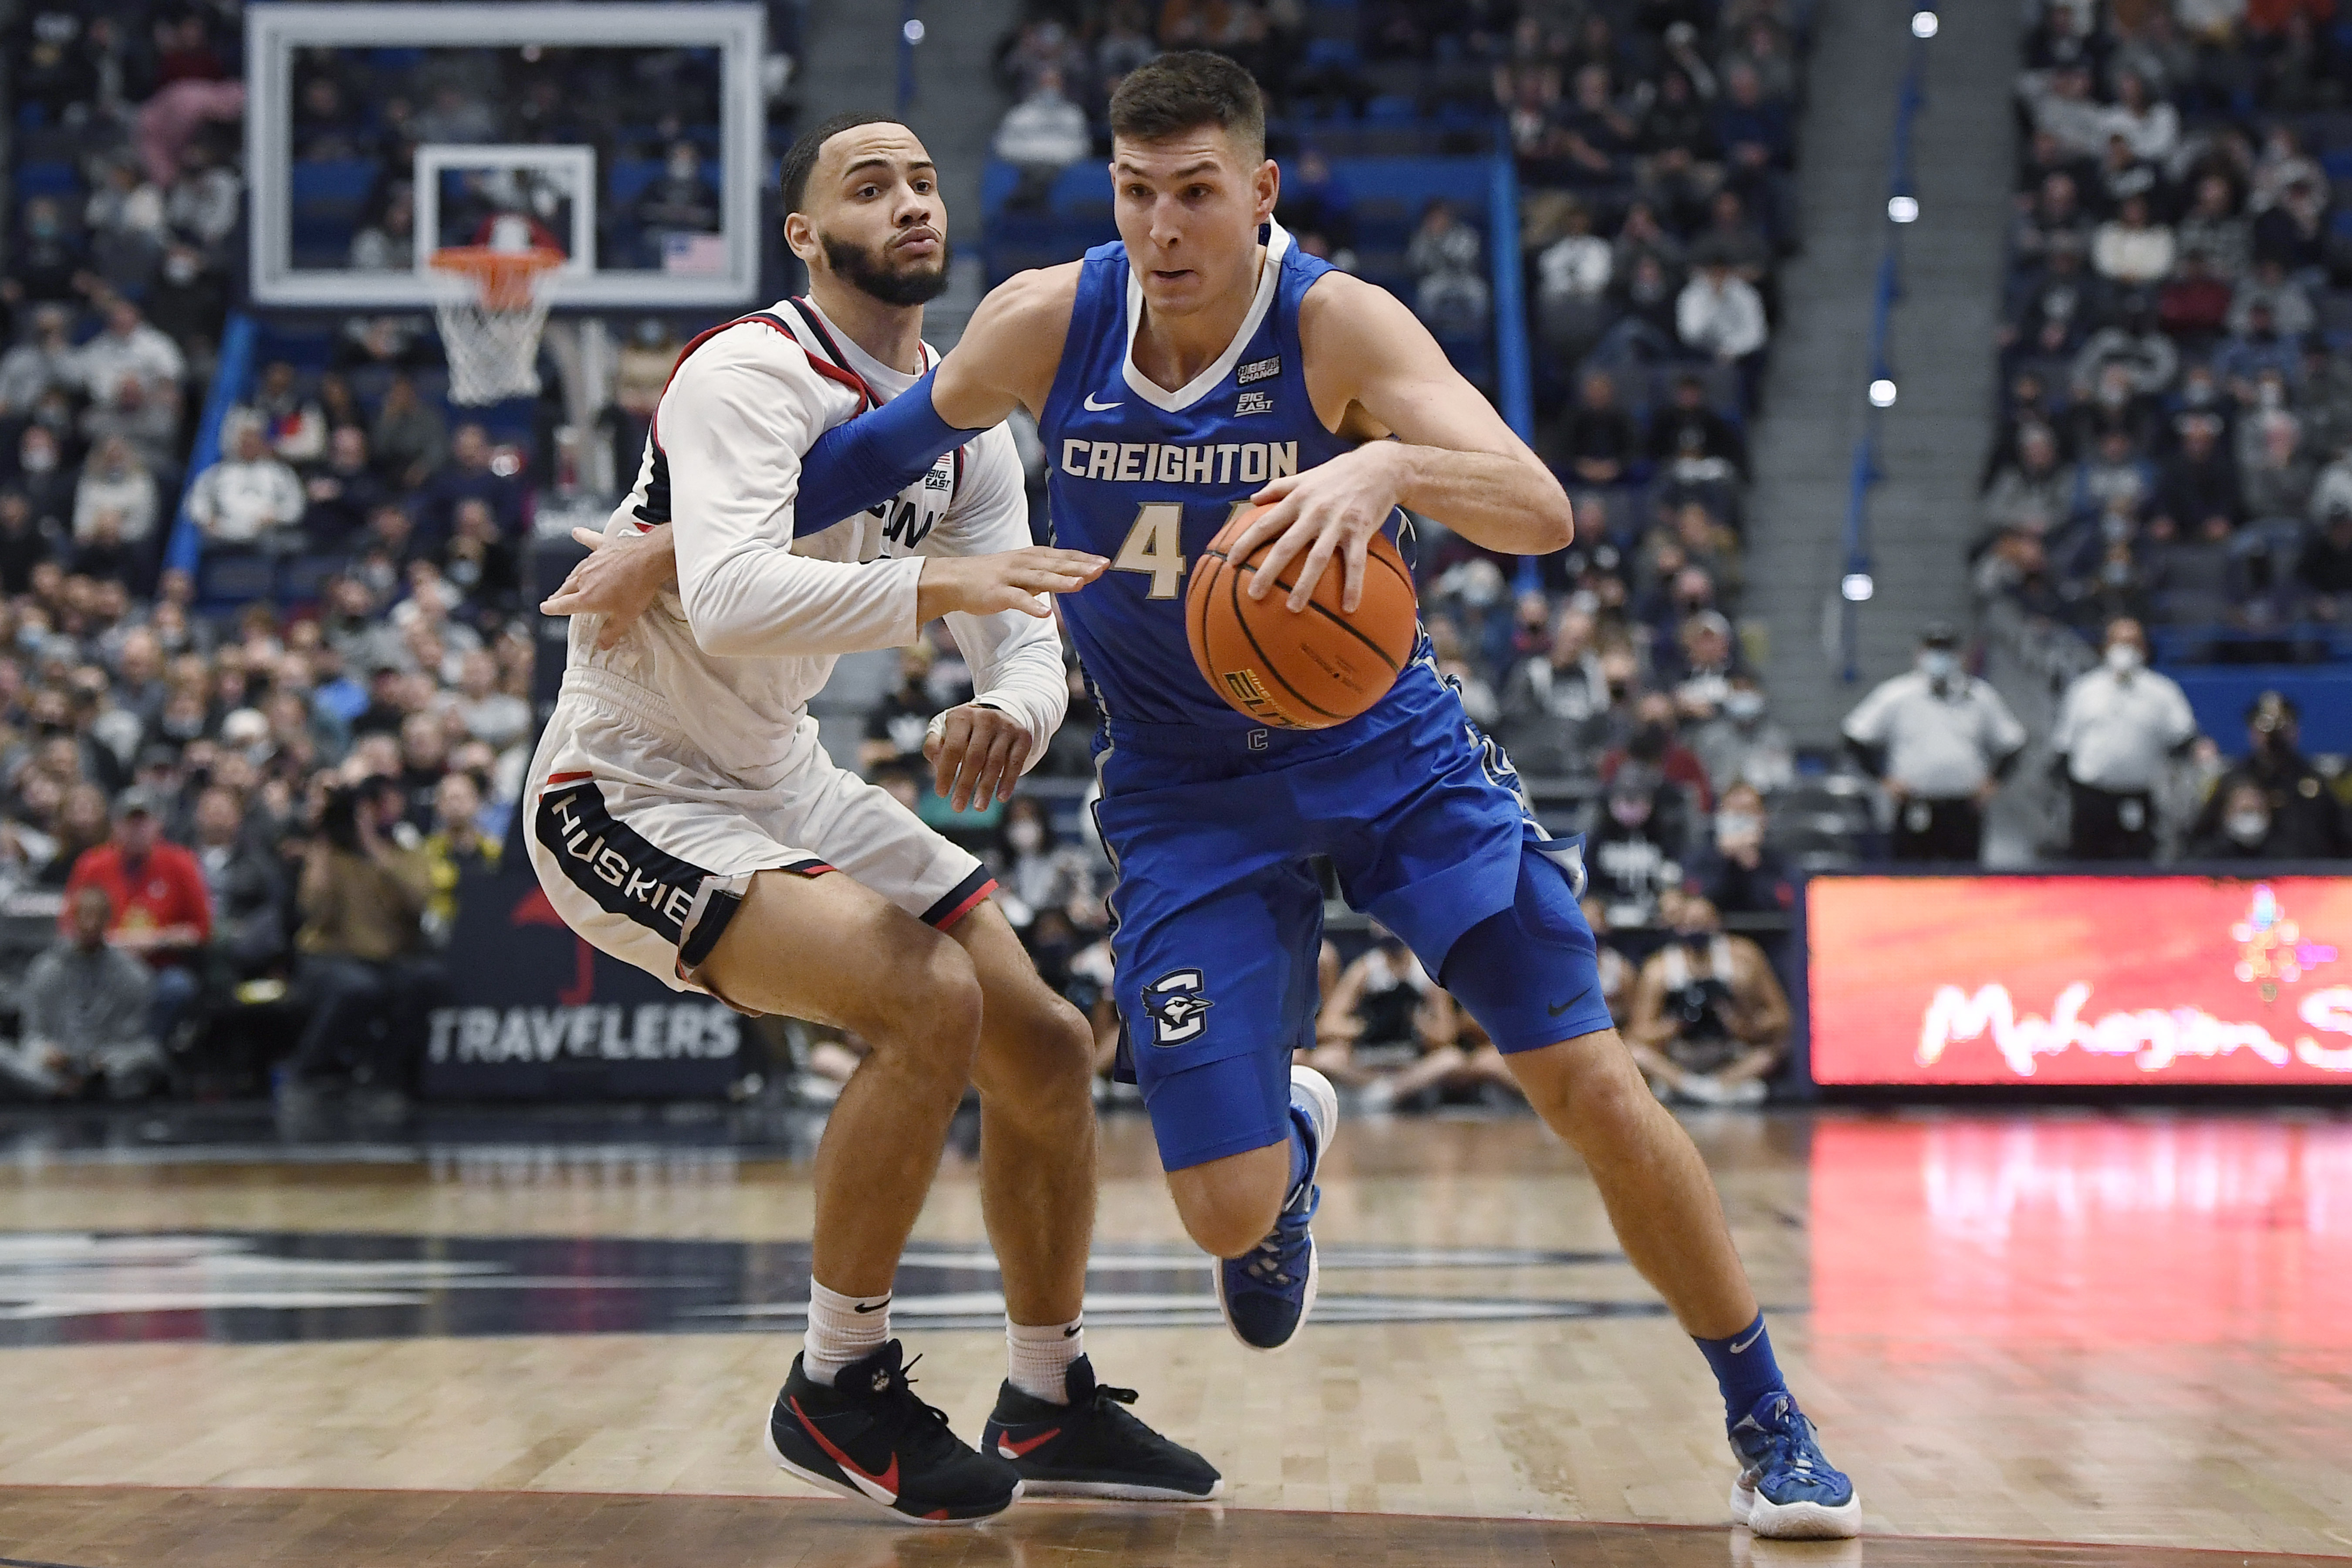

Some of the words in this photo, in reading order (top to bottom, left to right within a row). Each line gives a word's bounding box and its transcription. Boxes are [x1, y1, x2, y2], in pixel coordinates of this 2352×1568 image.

[1239, 367, 1280, 384] CHANGE
[1239, 392, 1264, 403] BIG
[1236, 400, 1274, 412] EAST
[1061, 439, 1298, 484] CREIGHTON
[928, 470, 947, 479] BIG
[926, 478, 951, 488] EAST
[428, 1004, 741, 1064] TRAVELERS
